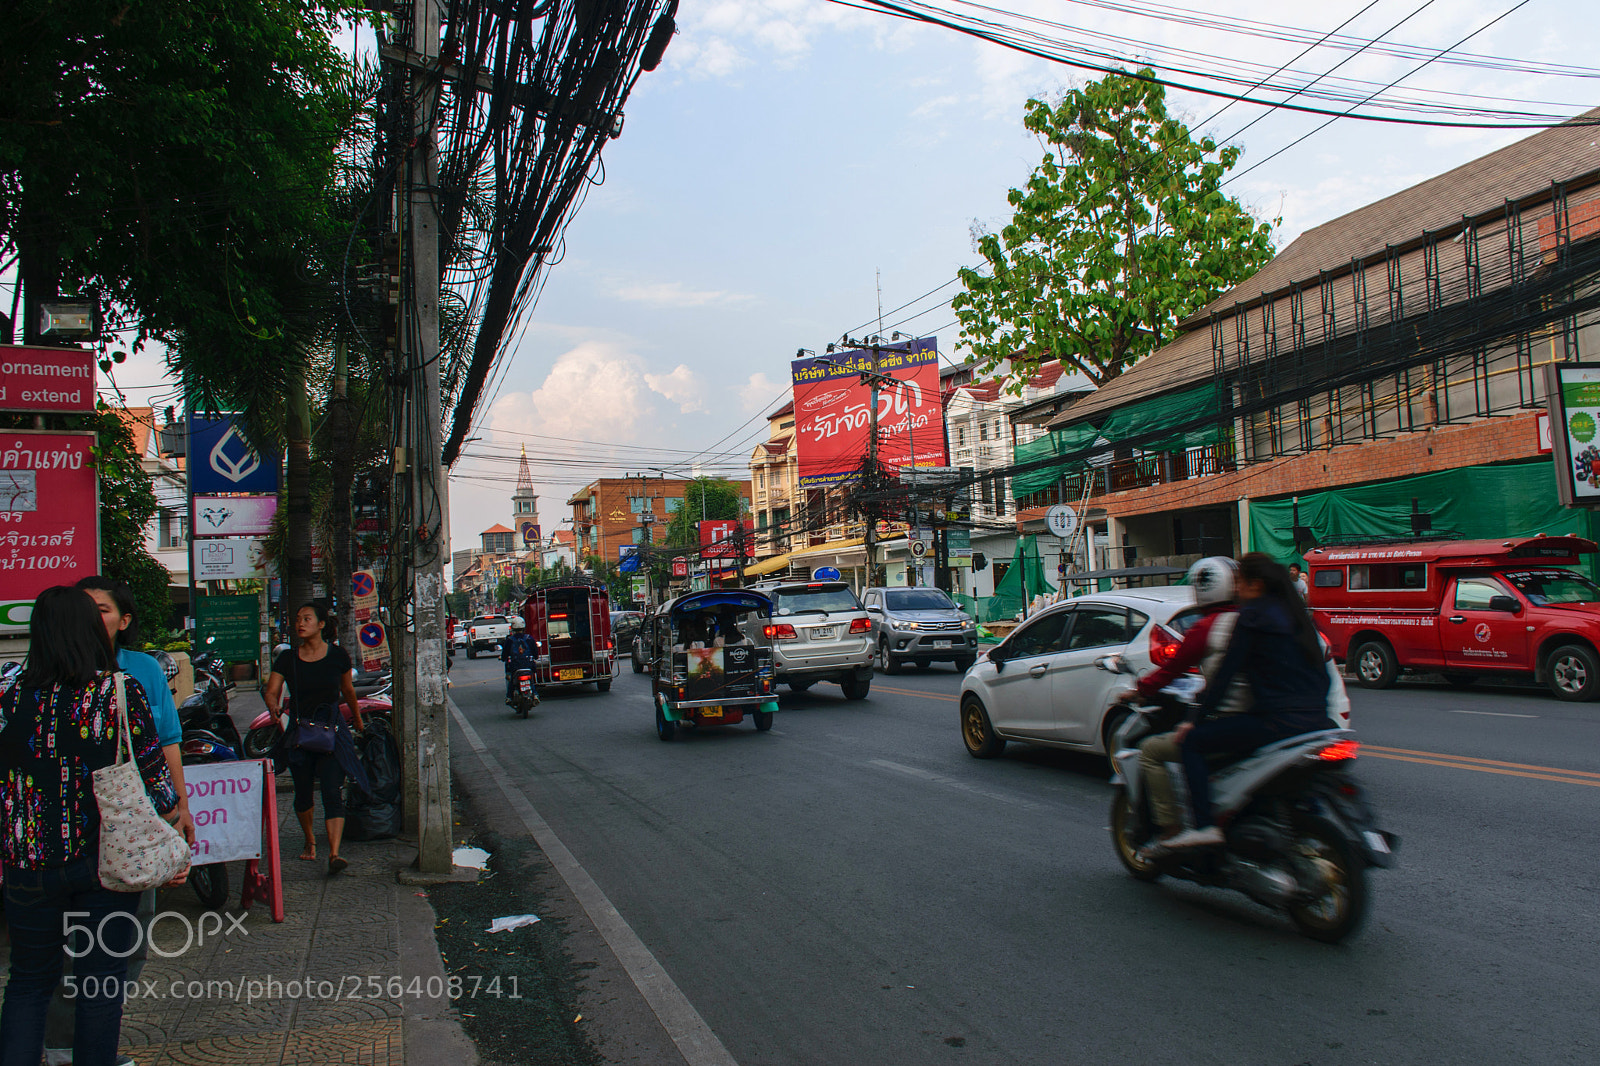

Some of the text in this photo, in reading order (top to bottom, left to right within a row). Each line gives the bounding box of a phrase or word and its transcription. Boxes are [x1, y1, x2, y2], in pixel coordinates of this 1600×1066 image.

[2, 362, 90, 378] ornament
[21, 388, 81, 403] extend
[208, 543, 227, 553] DD
